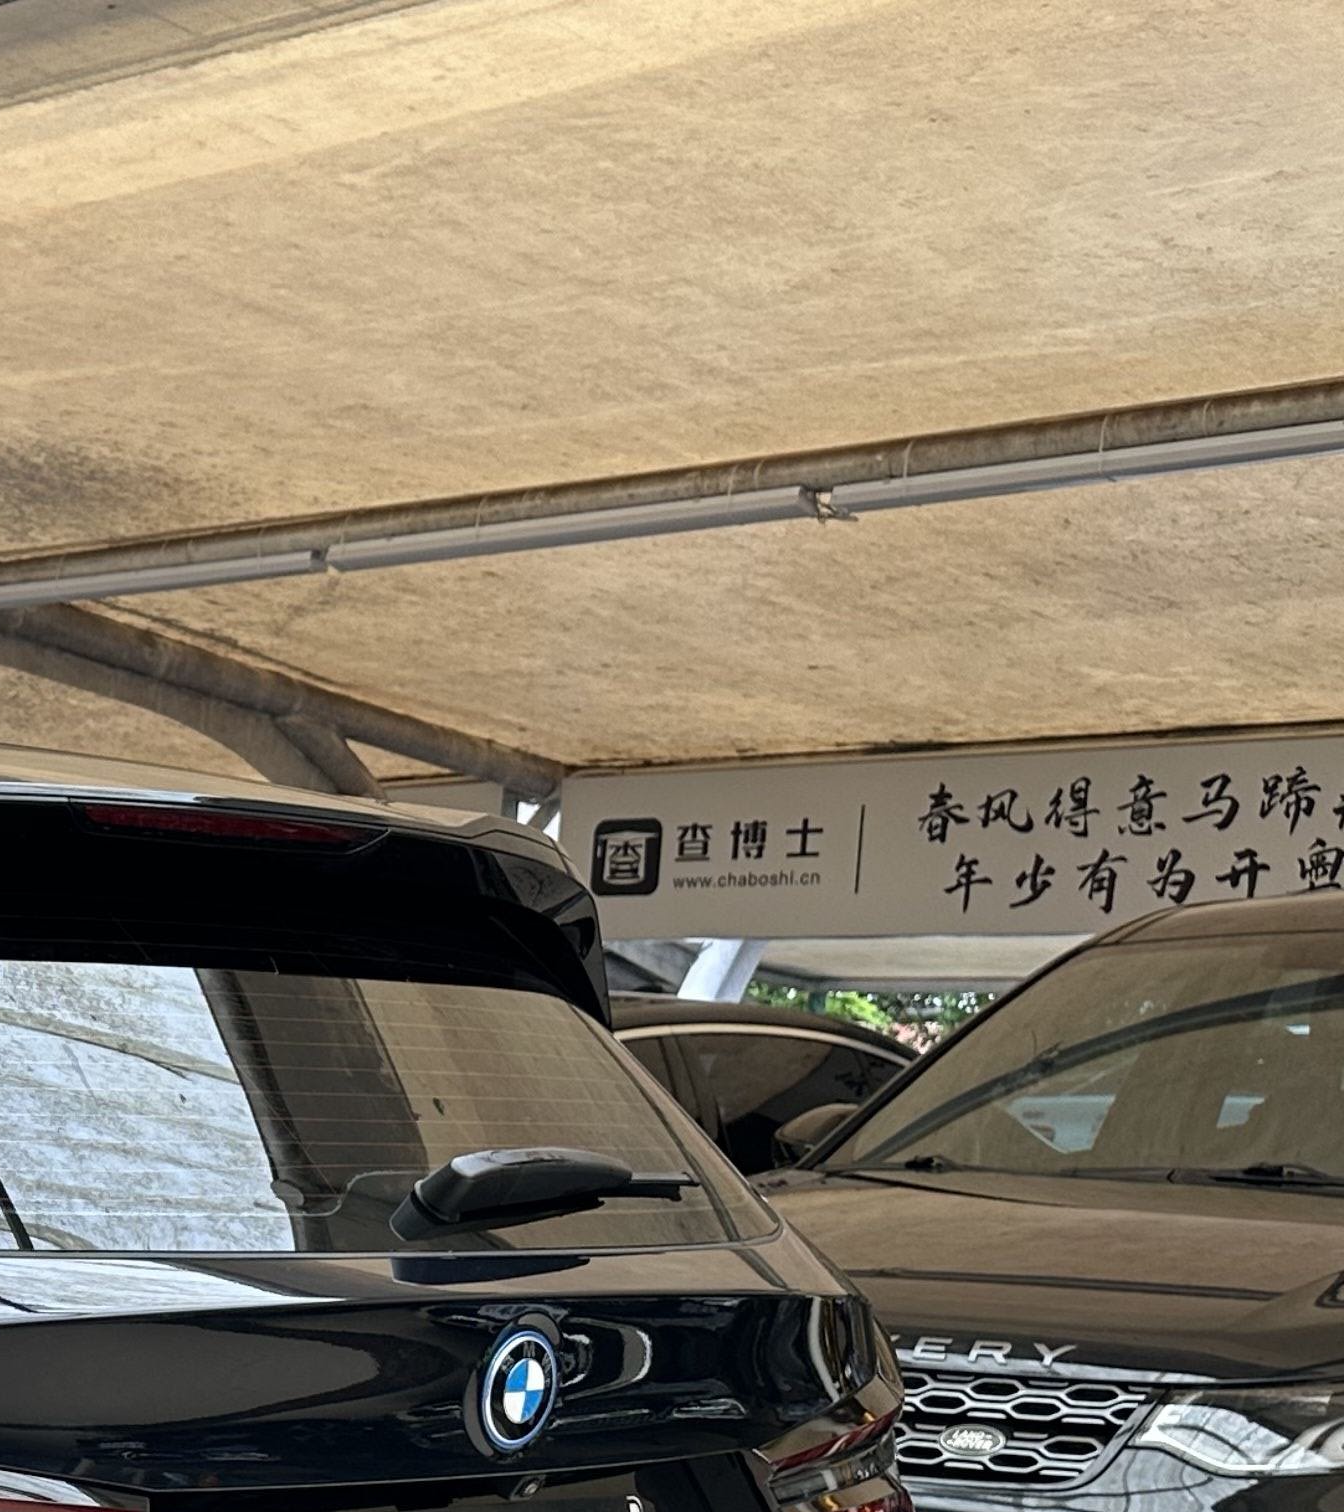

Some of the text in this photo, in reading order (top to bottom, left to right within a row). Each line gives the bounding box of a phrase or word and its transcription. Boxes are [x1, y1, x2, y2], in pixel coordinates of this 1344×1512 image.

[674, 816, 824, 862] 查博士
[673, 870, 821, 889] www.chaboshi.cn
[890, 1334, 1078, 1368] ERY
